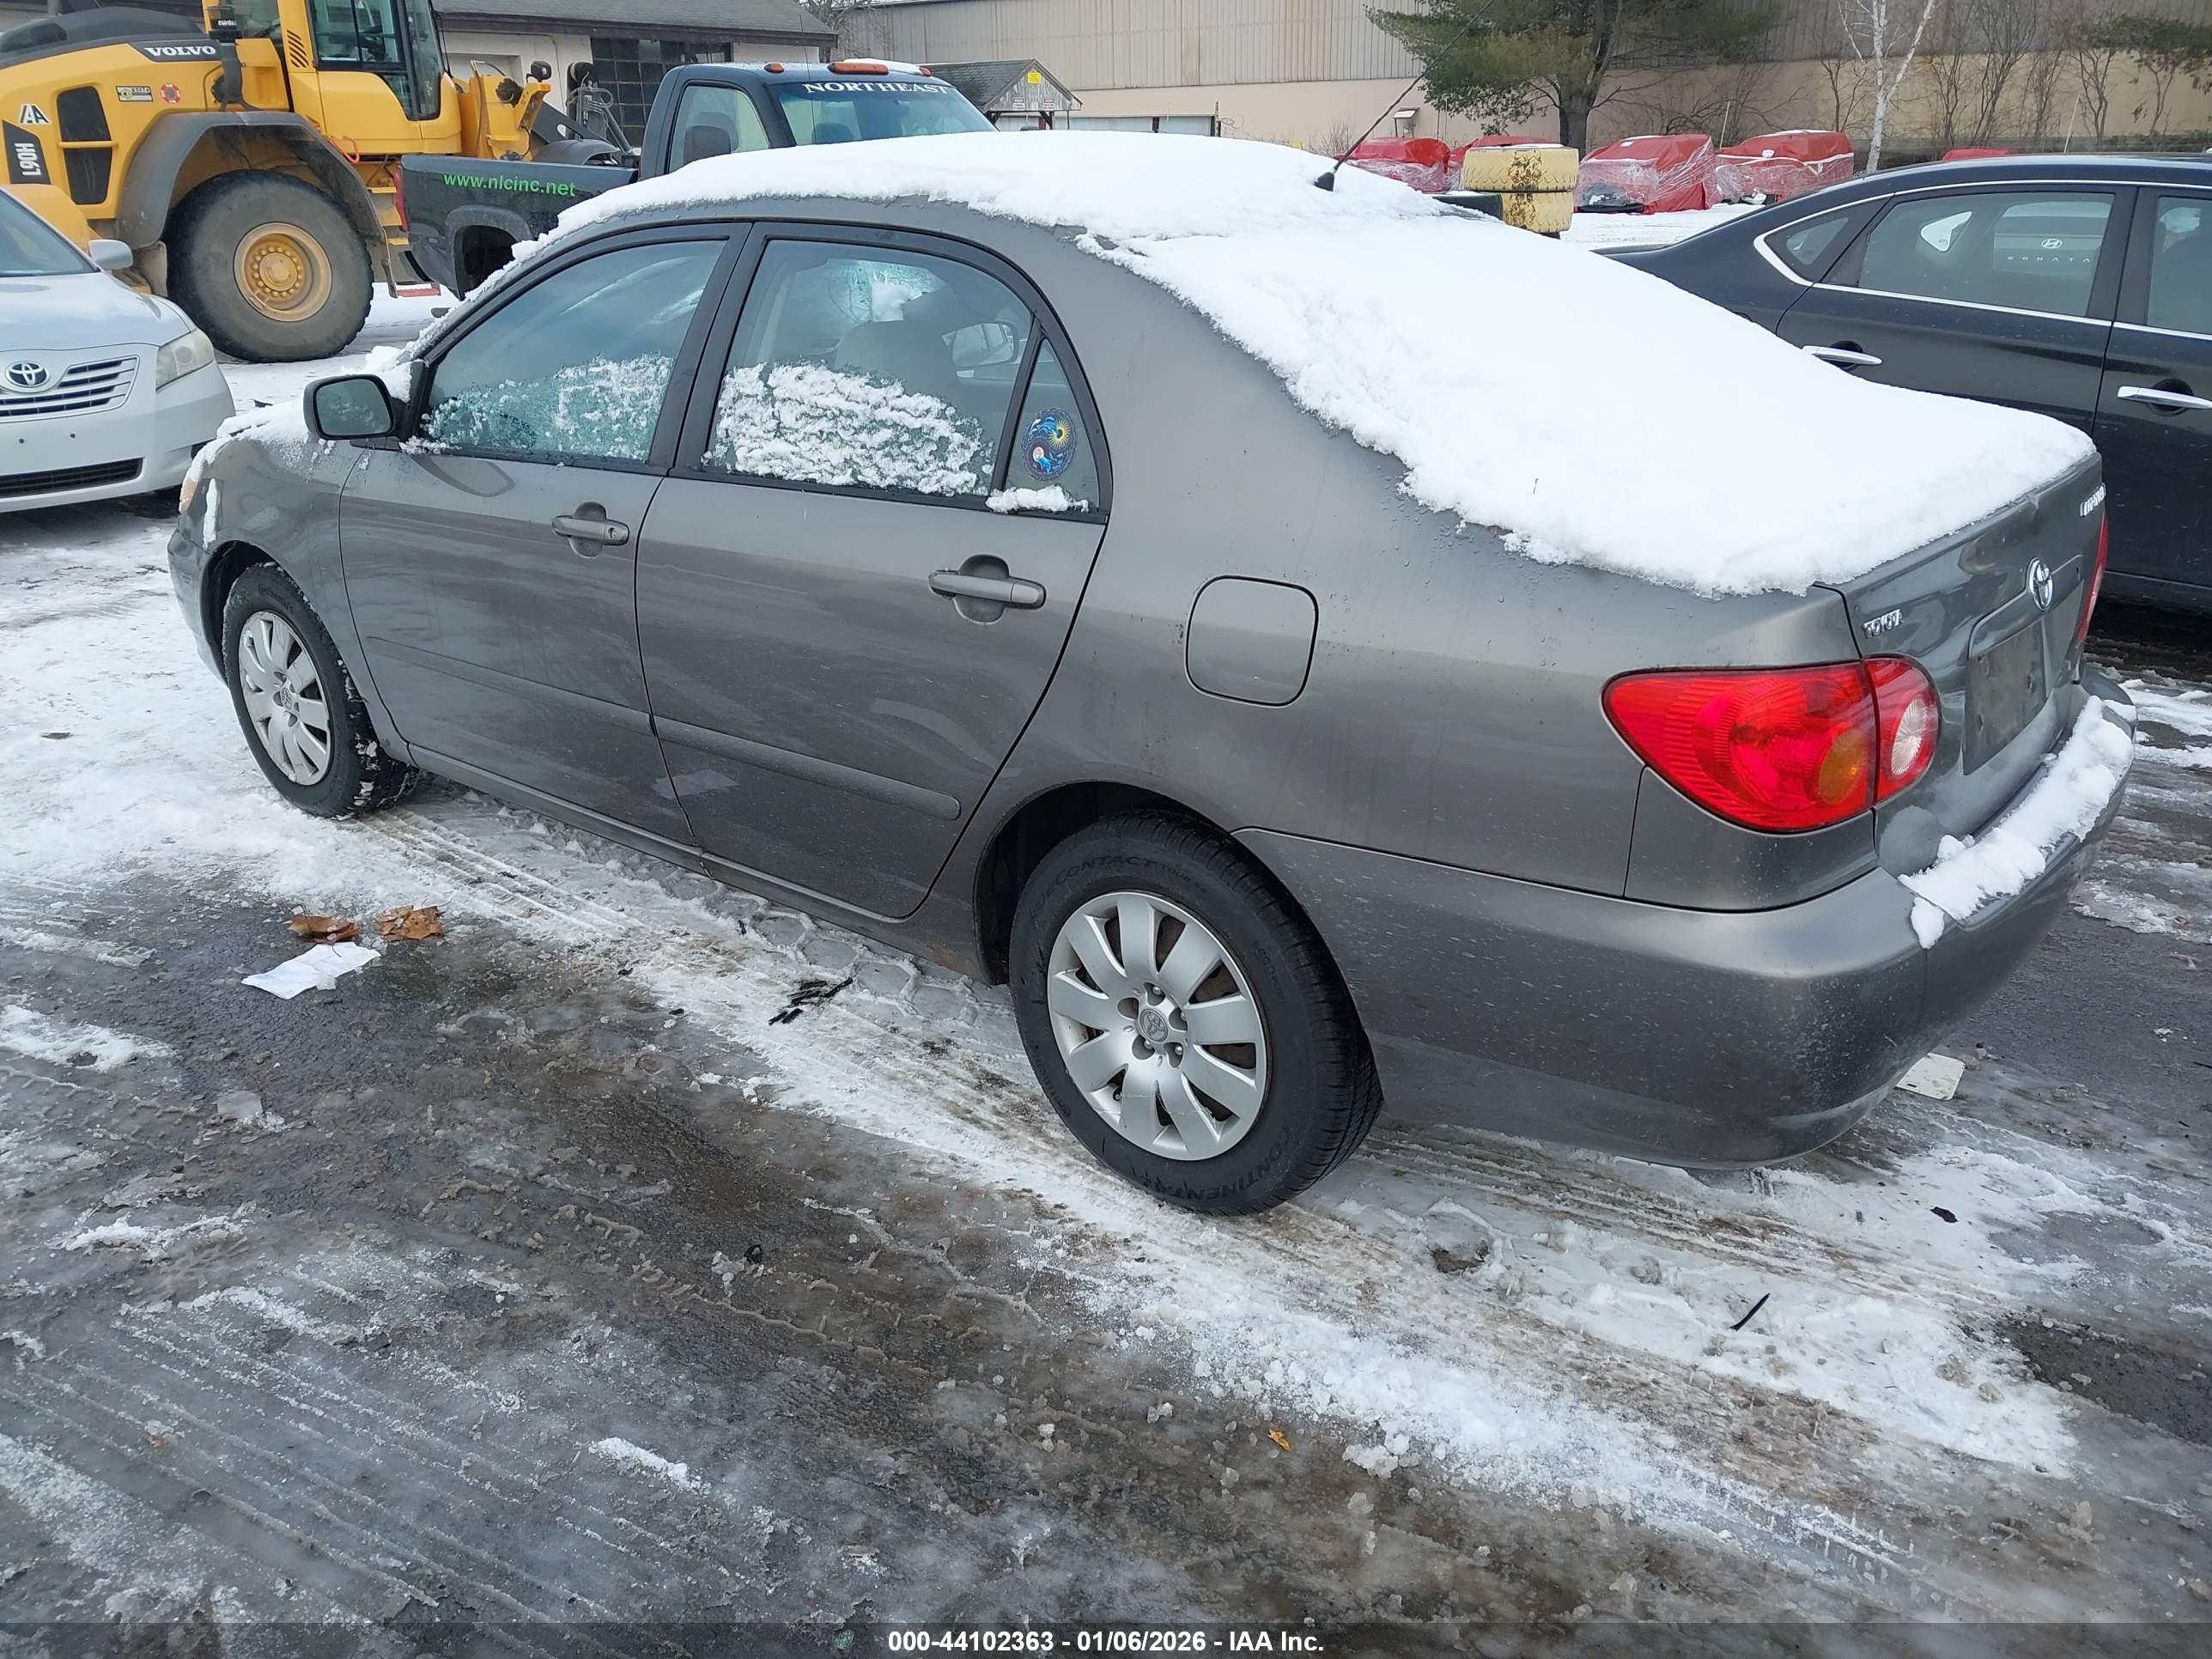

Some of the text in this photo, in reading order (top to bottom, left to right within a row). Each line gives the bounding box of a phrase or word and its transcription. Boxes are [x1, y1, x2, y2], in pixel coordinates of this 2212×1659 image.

[144, 46, 216, 57] VOLVO
[801, 82, 948, 94] NORTHEAST
[15, 143, 41, 176] L90H
[443, 173, 576, 197] www.nlcinc.net
